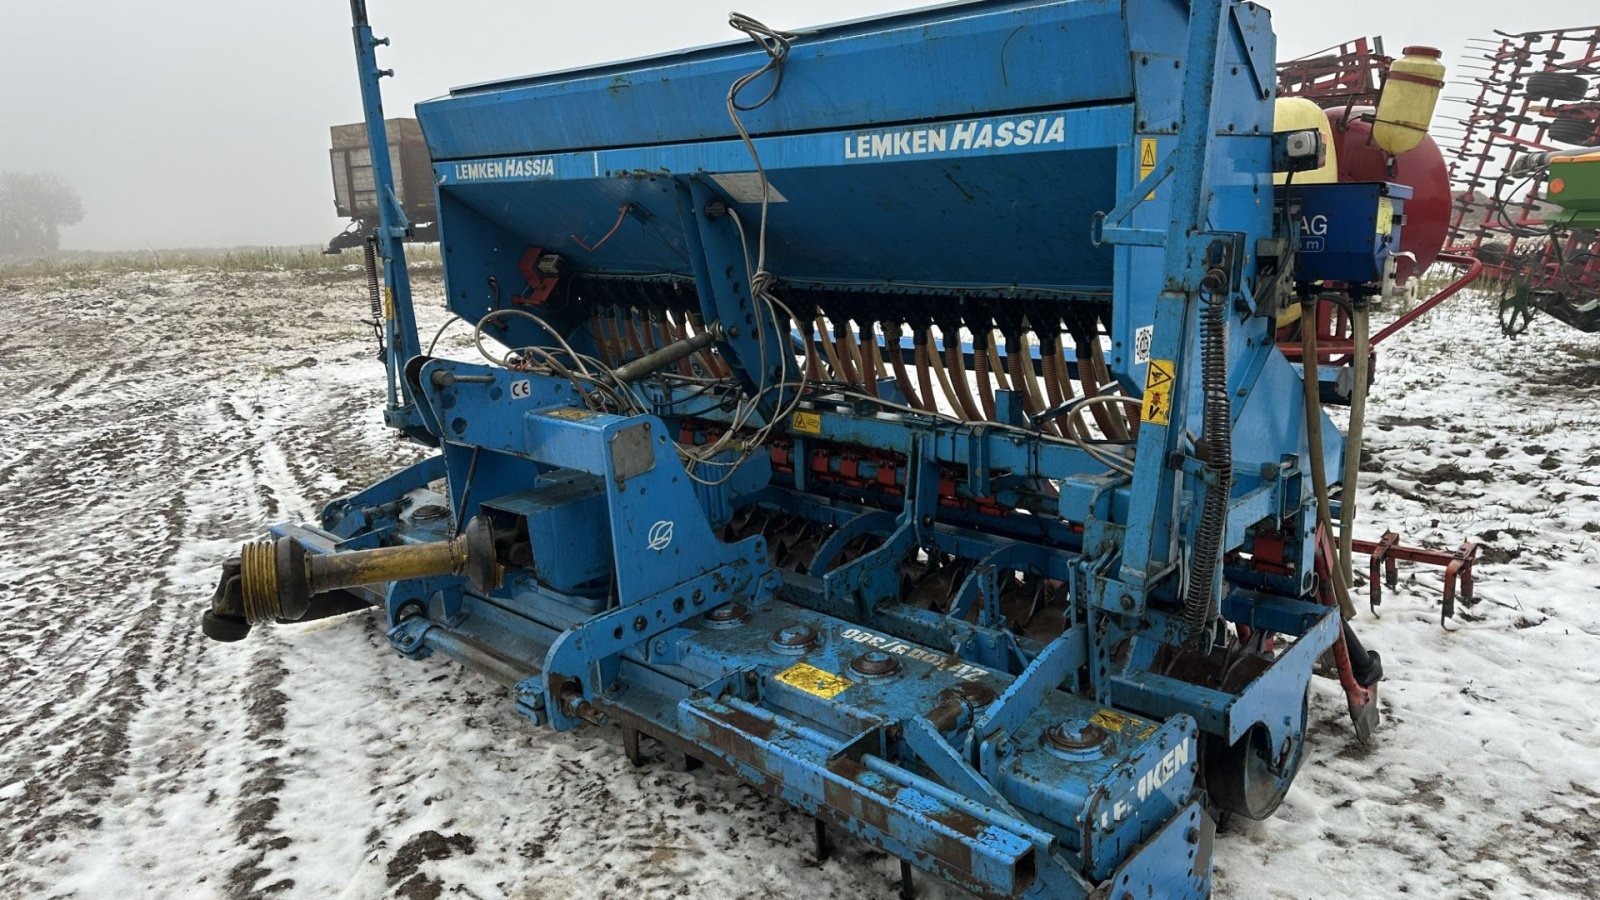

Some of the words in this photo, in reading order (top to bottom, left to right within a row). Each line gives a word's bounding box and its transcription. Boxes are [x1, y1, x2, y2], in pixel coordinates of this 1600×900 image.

[845, 129, 946, 160] LEMKEN
[950, 117, 1065, 150] HASSIA
[456, 162, 503, 181] LEMKEN
[505, 159, 554, 177] HASSIA
[512, 381, 529, 397] CE
